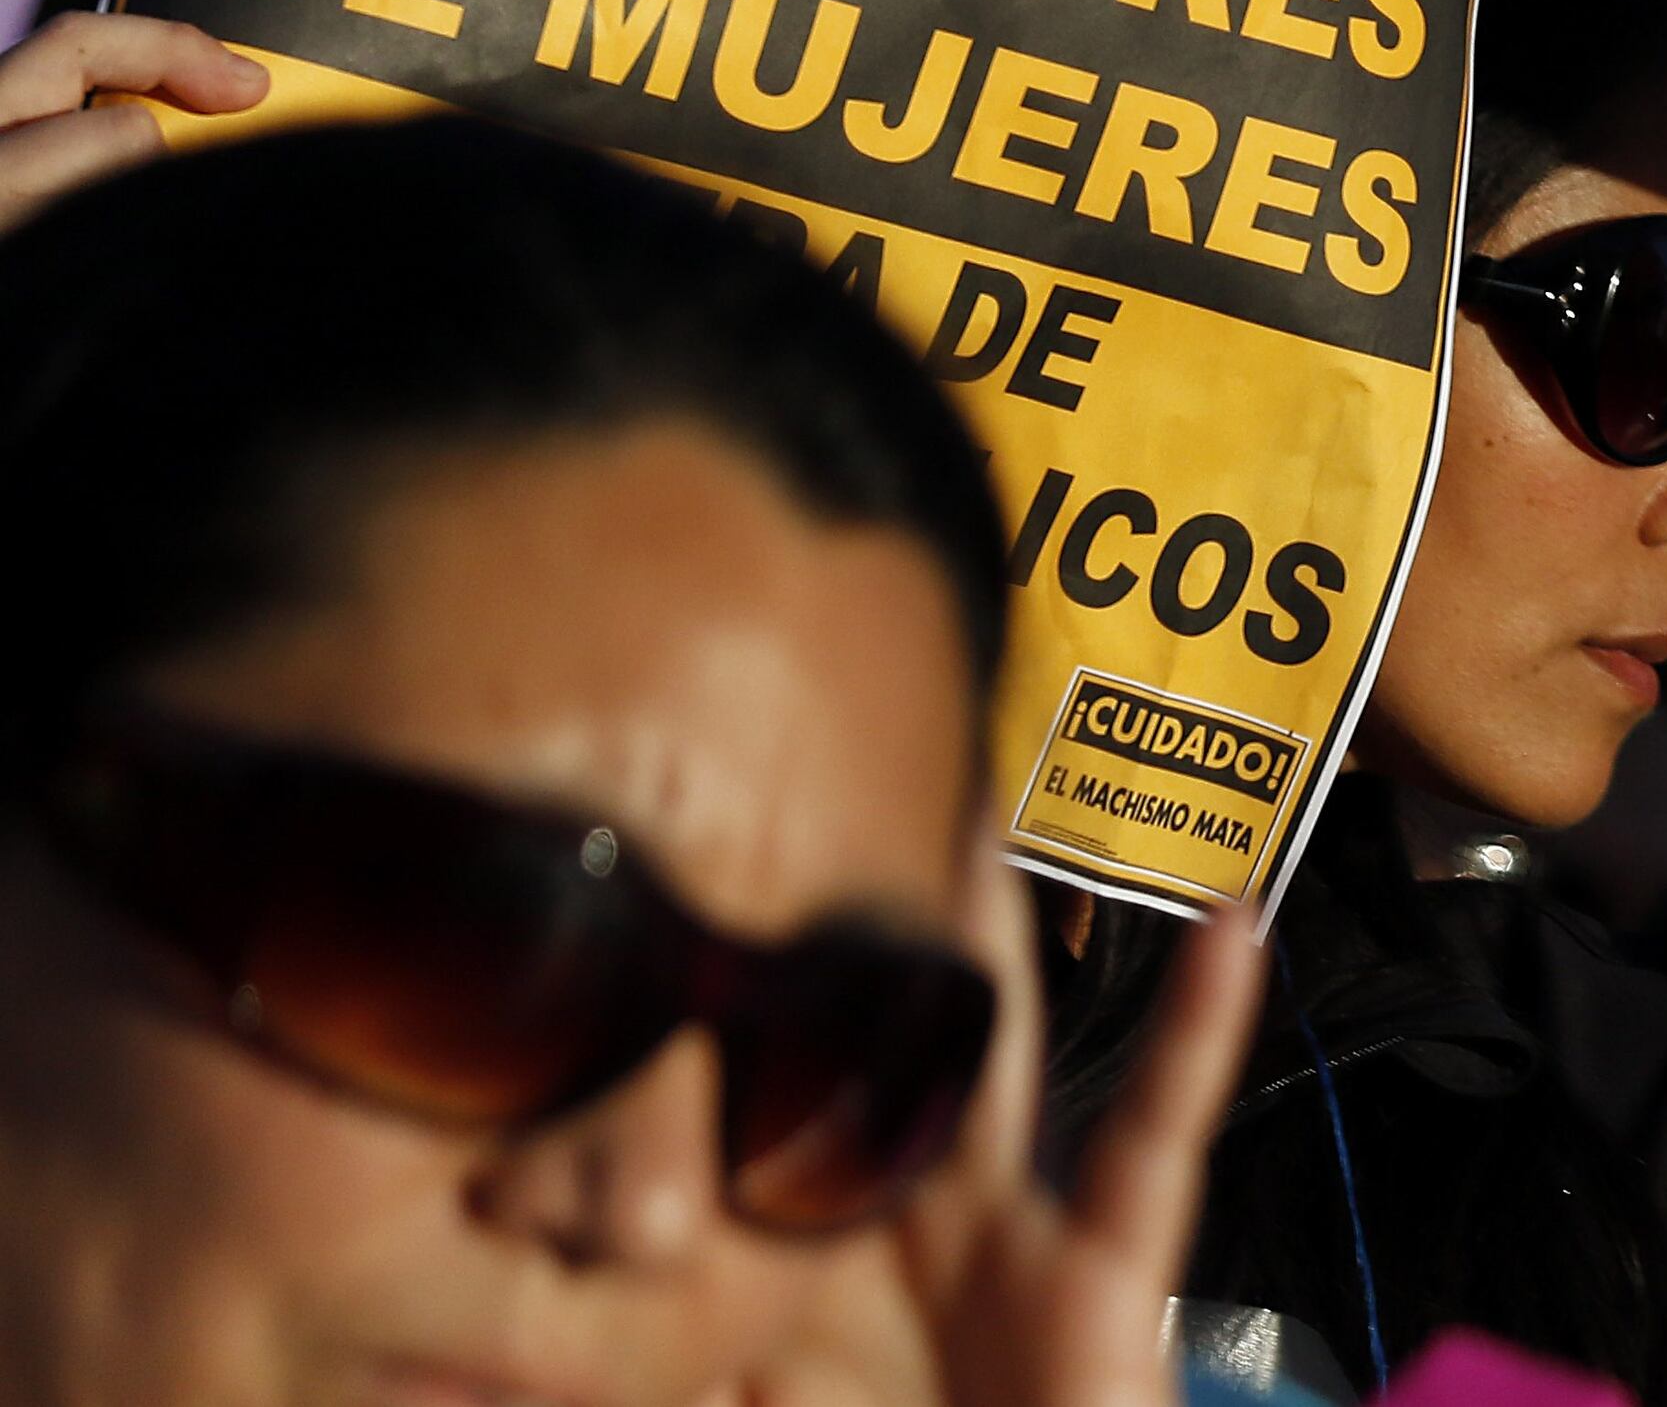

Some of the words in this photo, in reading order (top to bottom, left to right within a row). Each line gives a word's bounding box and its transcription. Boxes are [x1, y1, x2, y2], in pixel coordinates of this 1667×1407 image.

[920, 261, 1121, 412] DE
[1003, 468, 1345, 665] ICOS
[1067, 696, 1288, 790] ¡CUIDADO!
[1044, 765, 1065, 796] EL
[1071, 775, 1190, 831] MACHISMO
[1191, 809, 1253, 855] MATA
